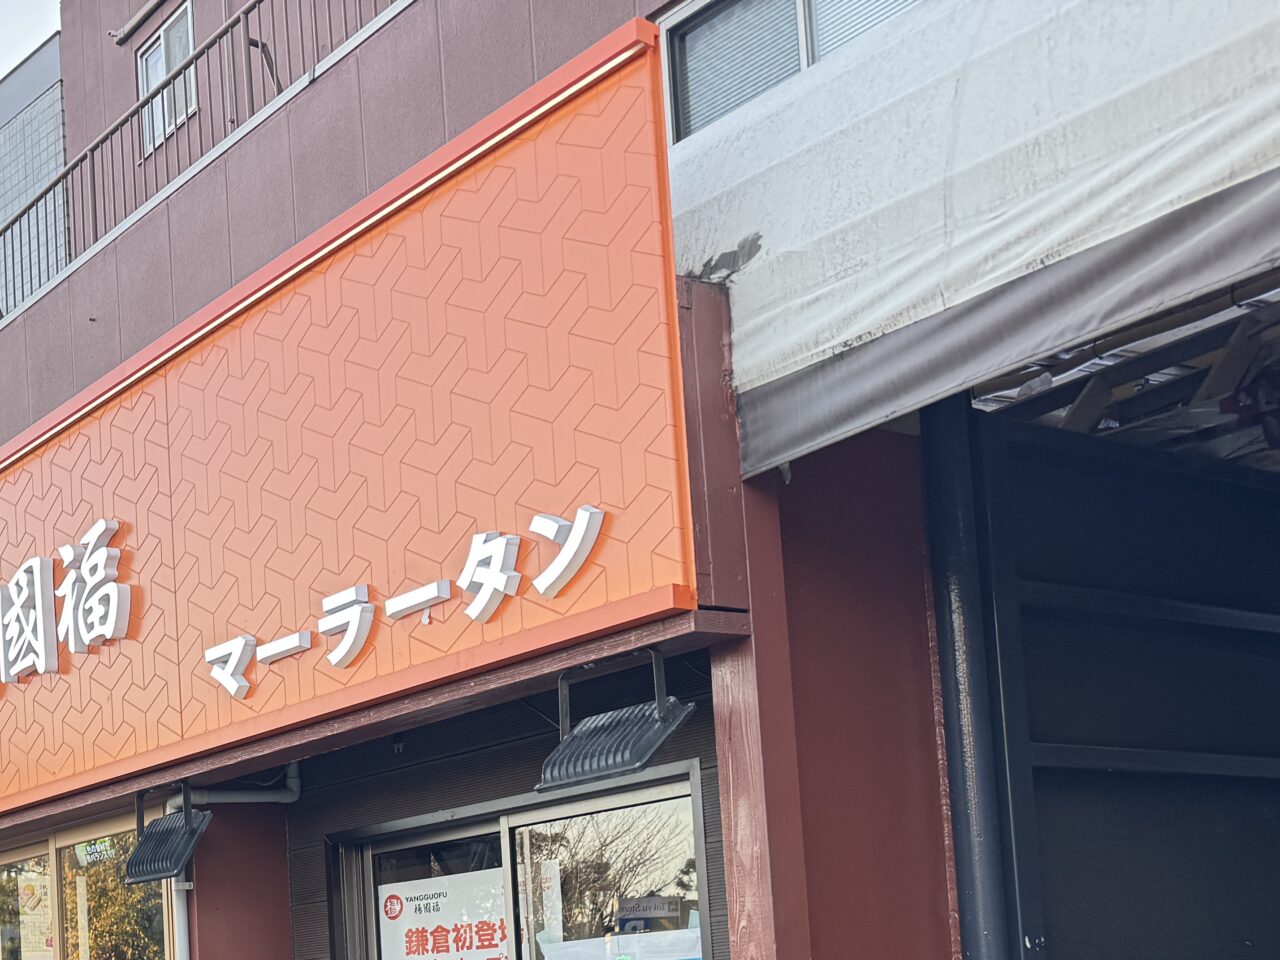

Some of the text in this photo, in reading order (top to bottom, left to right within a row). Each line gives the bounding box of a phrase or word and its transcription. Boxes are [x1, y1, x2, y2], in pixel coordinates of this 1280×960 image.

[204, 505, 605, 699] マーラータン
[405, 891, 448, 903] YANGGUOFU
